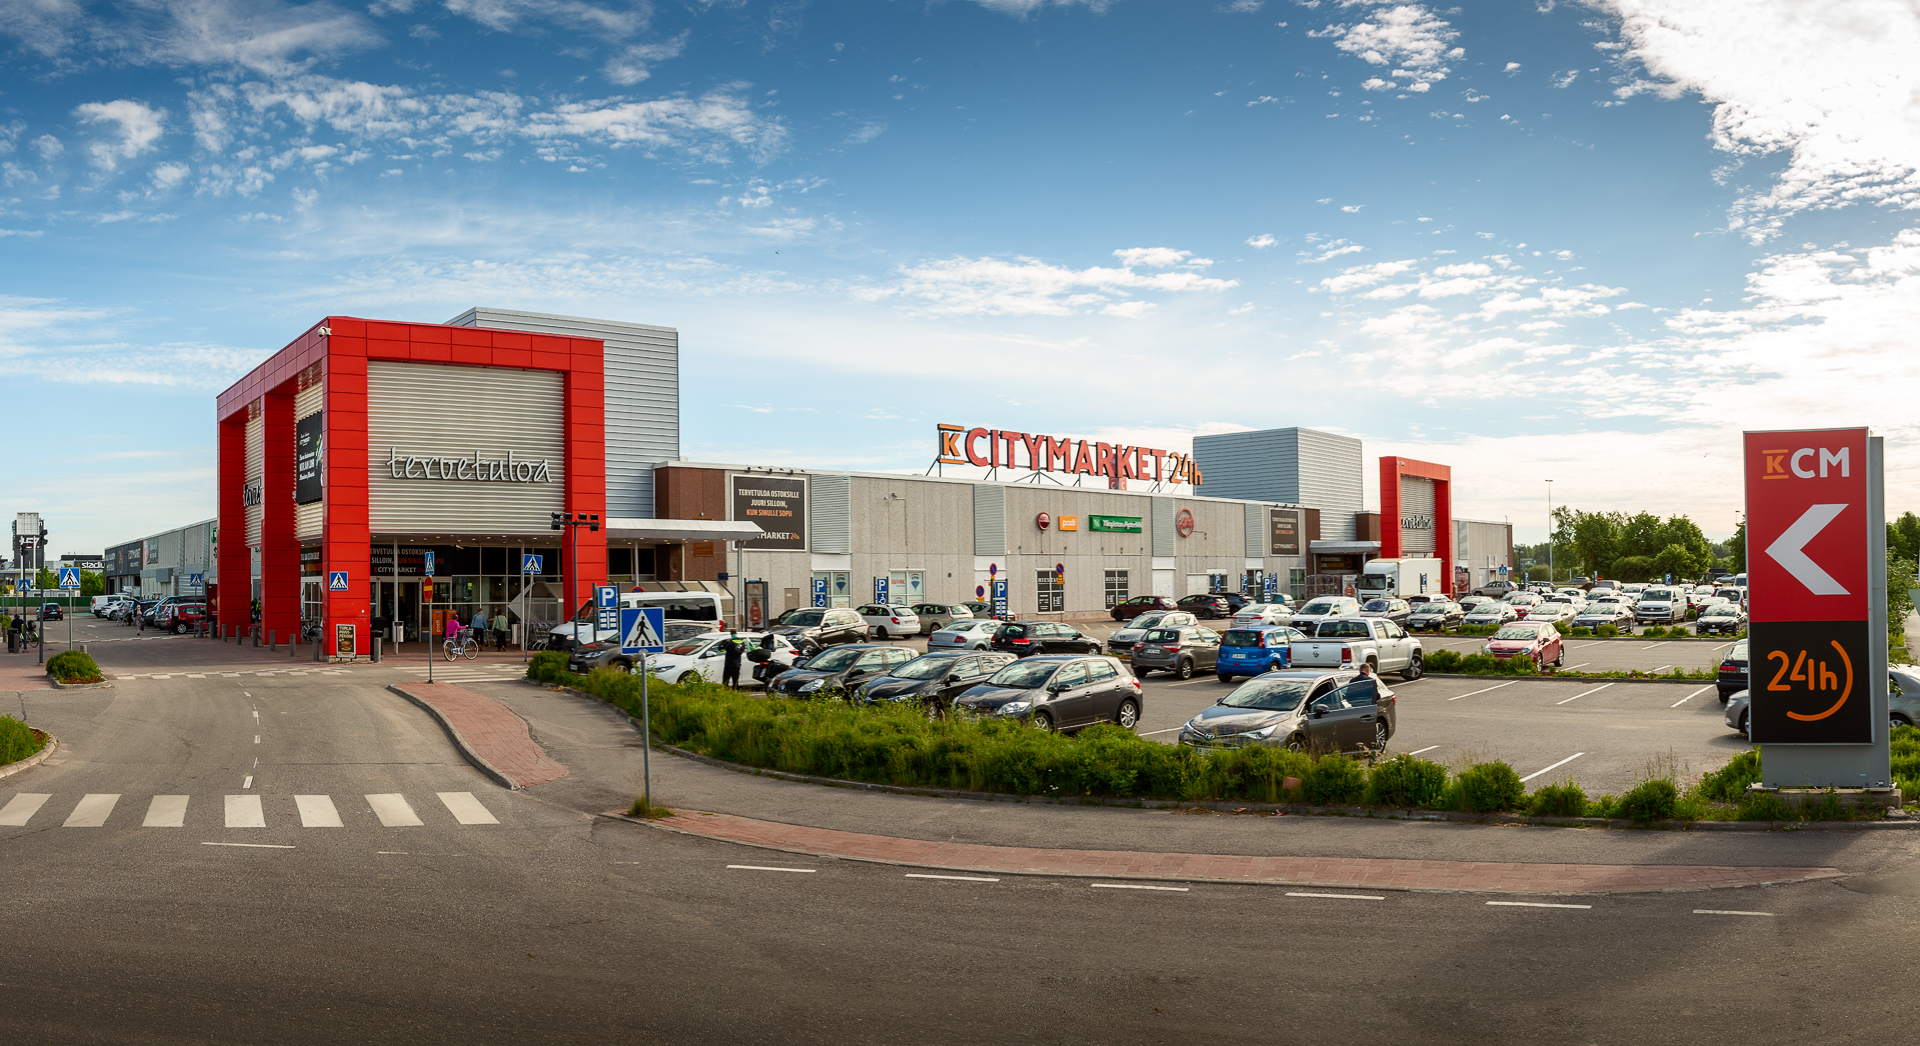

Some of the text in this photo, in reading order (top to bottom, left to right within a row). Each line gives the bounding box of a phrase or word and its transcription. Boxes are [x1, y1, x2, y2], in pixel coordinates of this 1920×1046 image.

[965, 427, 1167, 482] CITYMARKET
[1170, 451, 1203, 486] 24h
[1791, 446, 1850, 479] CM
[387, 446, 552, 483] tervetuloa
[738, 488, 800, 499] TERVETULOA OSTOKSILLE
[746, 508, 758, 516] KUN
[759, 509, 778, 517] SINULLE
[757, 531, 790, 540] MARKET
[817, 580, 824, 592] P
[879, 579, 885, 591] P
[998, 582, 1005, 597] P
[1265, 578, 1270, 589] P
[602, 588, 614, 606] P
[1767, 650, 1838, 691] 24h
